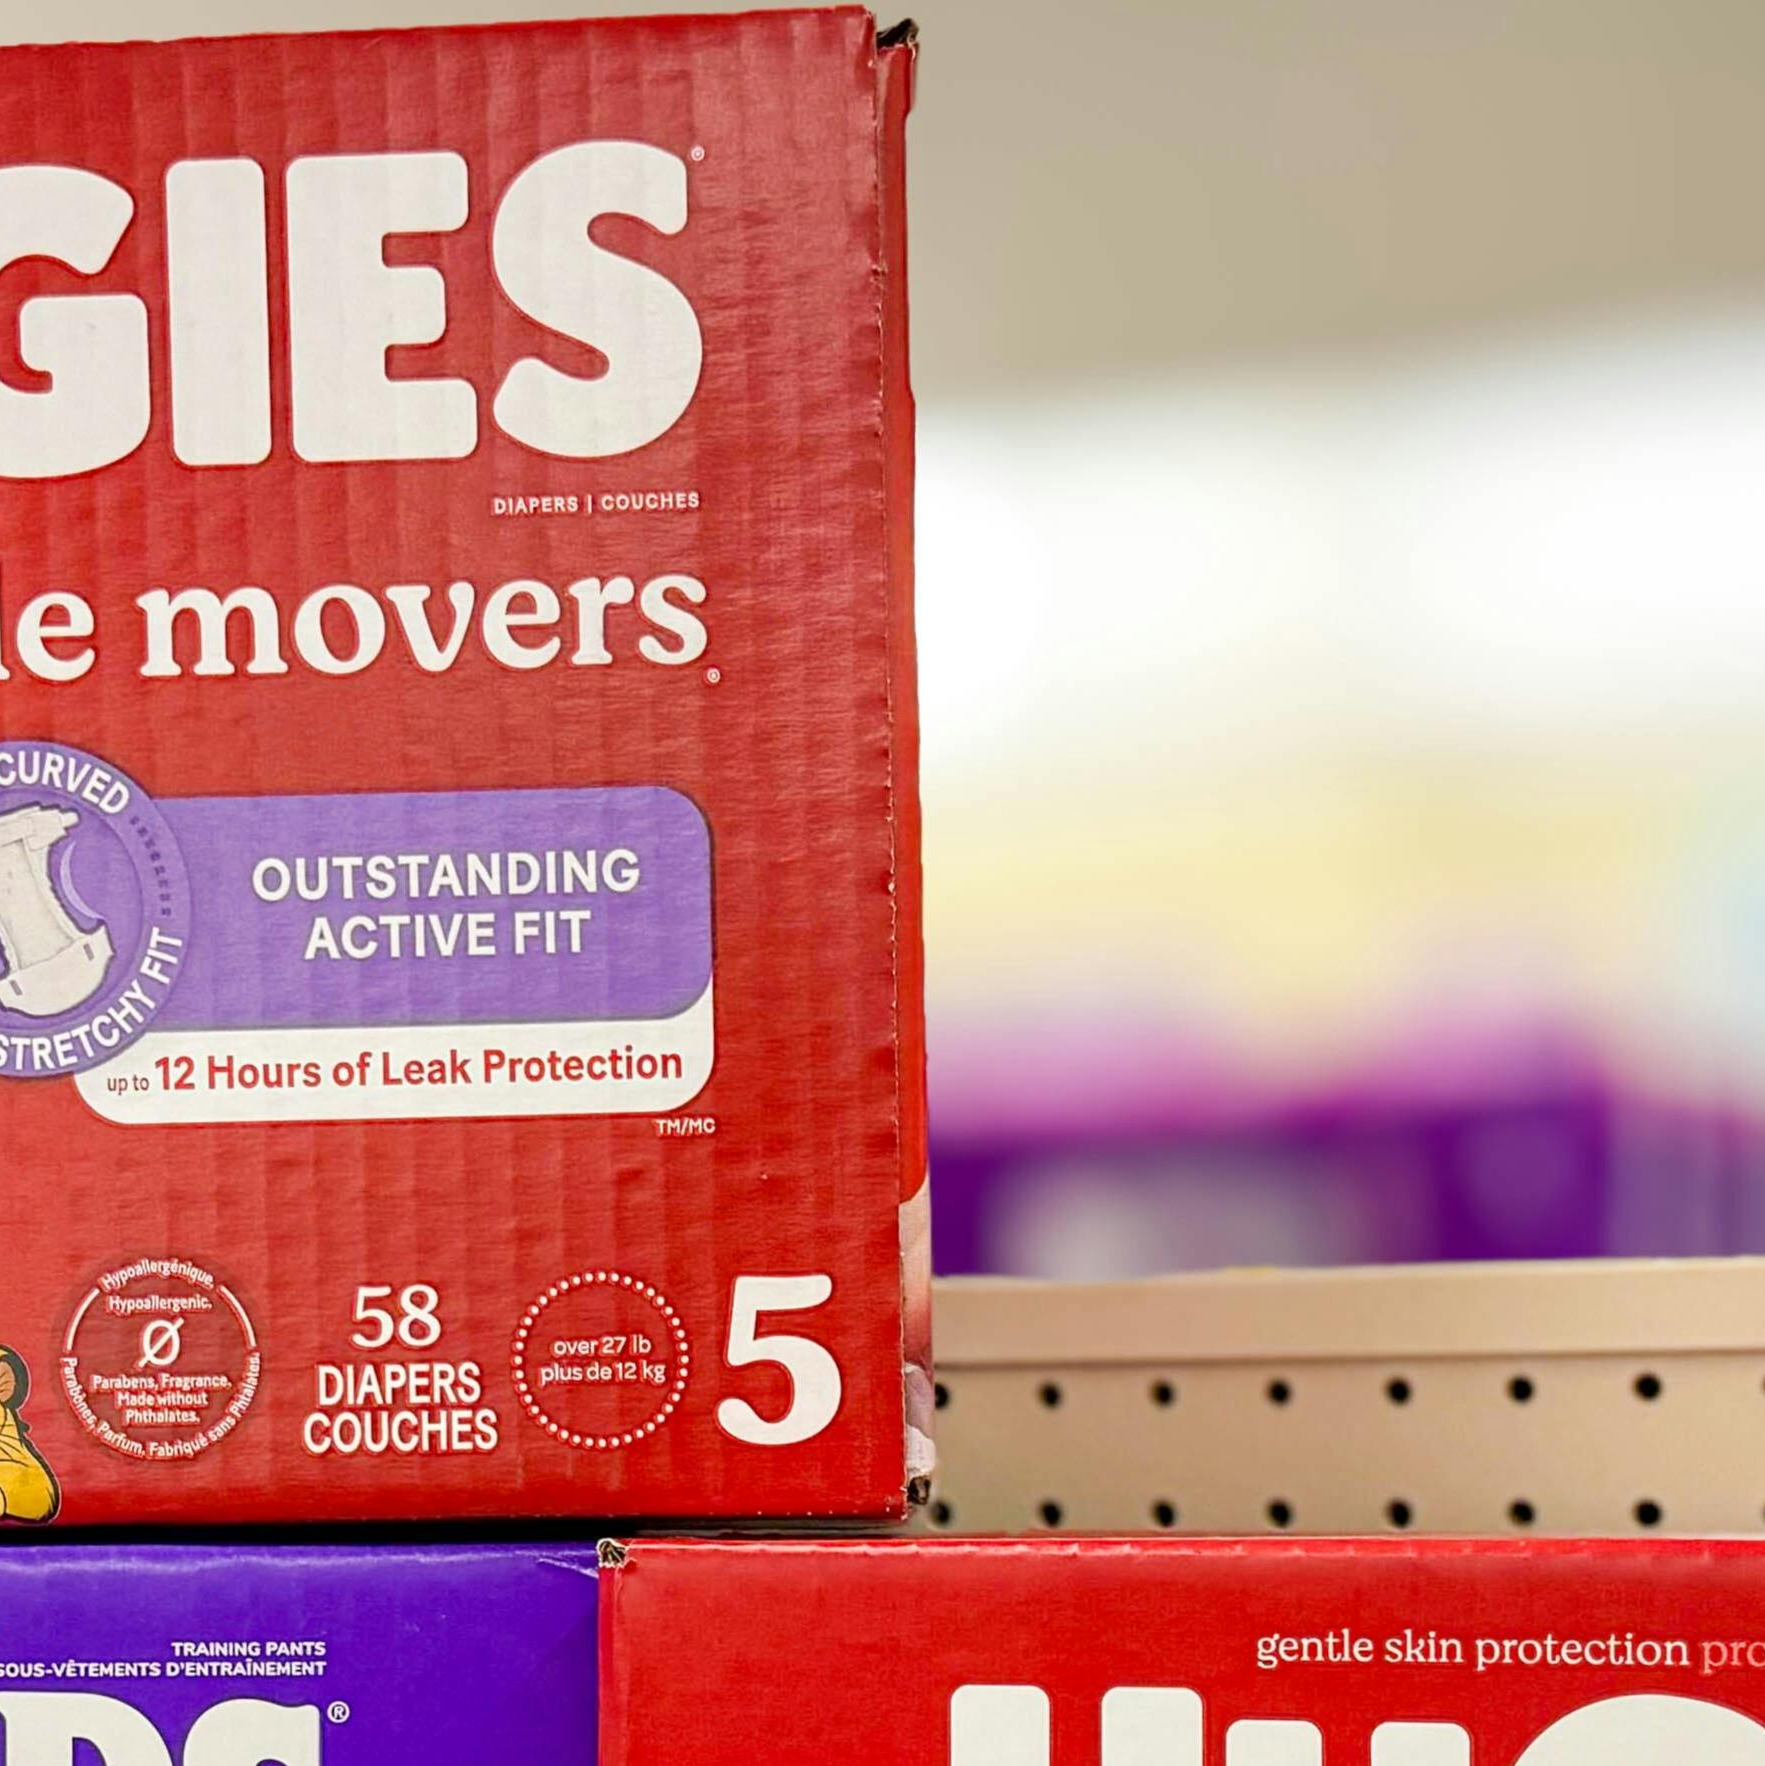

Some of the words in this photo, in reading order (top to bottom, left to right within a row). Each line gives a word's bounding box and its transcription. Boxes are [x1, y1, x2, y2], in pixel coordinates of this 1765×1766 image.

[494, 496, 578, 514] DIAPERS
[601, 492, 699, 510] COUCHES
[137, 575, 707, 676] movers
[253, 849, 639, 900] OUTSTANDING
[140, 927, 183, 985] FIT
[305, 913, 495, 959] ACTIVE
[515, 910, 591, 954] FIT
[108, 1078, 128, 1095] up
[132, 1075, 149, 1091] to
[155, 1056, 195, 1090] 12
[208, 1056, 321, 1089] Hours
[333, 1052, 372, 1086] of
[383, 1049, 471, 1085] Leak
[484, 1045, 682, 1083] Protection
[353, 1285, 440, 1347] 58
[554, 1341, 598, 1355] over
[602, 1336, 626, 1354] 27
[633, 1335, 651, 1353] lb
[717, 1273, 842, 1446] 5
[319, 1362, 480, 1405] DIAPERS
[541, 1363, 582, 1386] plus
[586, 1362, 612, 1380] de
[615, 1362, 636, 1380] 12
[642, 1360, 665, 1383] kg
[118, 1393, 155, 1406] Made
[157, 1391, 208, 1406] without
[304, 1409, 497, 1453] COUCHES
[166, 1658, 326, 1676] D'ENTRAÎNEMENT
[171, 1642, 260, 1656] TRAINING
[266, 1642, 326, 1656] PANTS
[1258, 1628, 1373, 1669] gentle
[1385, 1629, 1463, 1662] skin
[1476, 1633, 1690, 1671] protection
